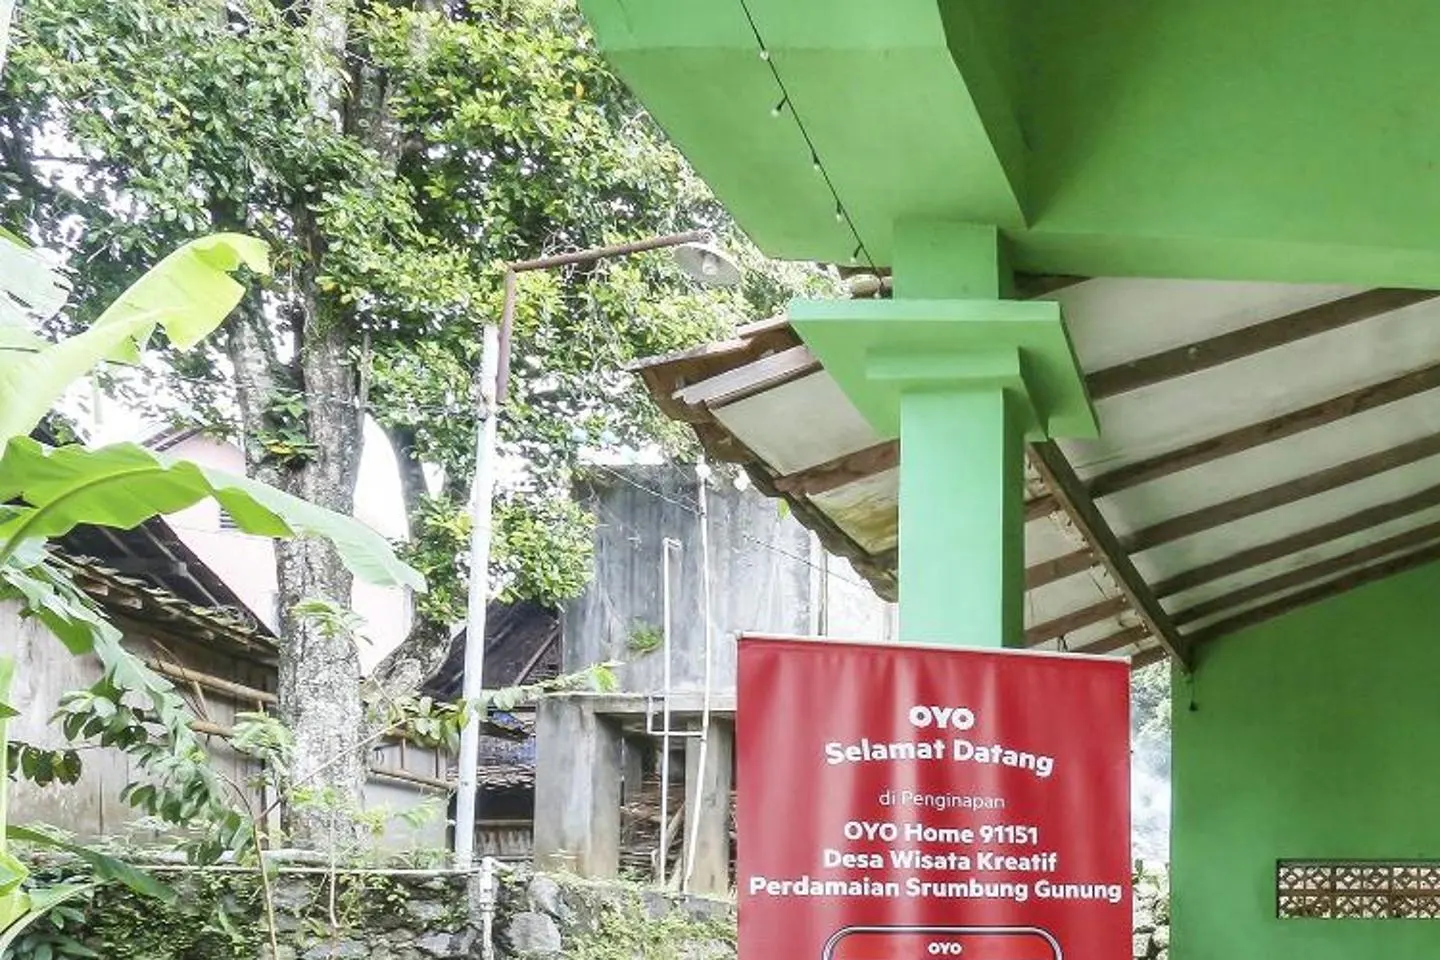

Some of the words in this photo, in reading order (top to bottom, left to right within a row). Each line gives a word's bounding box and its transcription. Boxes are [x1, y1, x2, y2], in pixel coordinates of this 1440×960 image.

[909, 706, 975, 730] OYO
[825, 738, 945, 765] Selamat
[953, 739, 1055, 777] Datang
[878, 789, 896, 805] di
[901, 790, 1006, 811] Penginapan
[844, 821, 898, 842] OYO
[905, 823, 974, 844] Home
[979, 824, 1038, 845] 91151
[823, 849, 884, 869] Desa
[890, 850, 971, 871] Wisata
[977, 851, 1057, 872] Kreatif
[749, 877, 900, 897] Perdamaian
[906, 877, 1028, 901] Srumbung
[1034, 880, 1122, 901] Gunung
[928, 942, 962, 955] OYO
